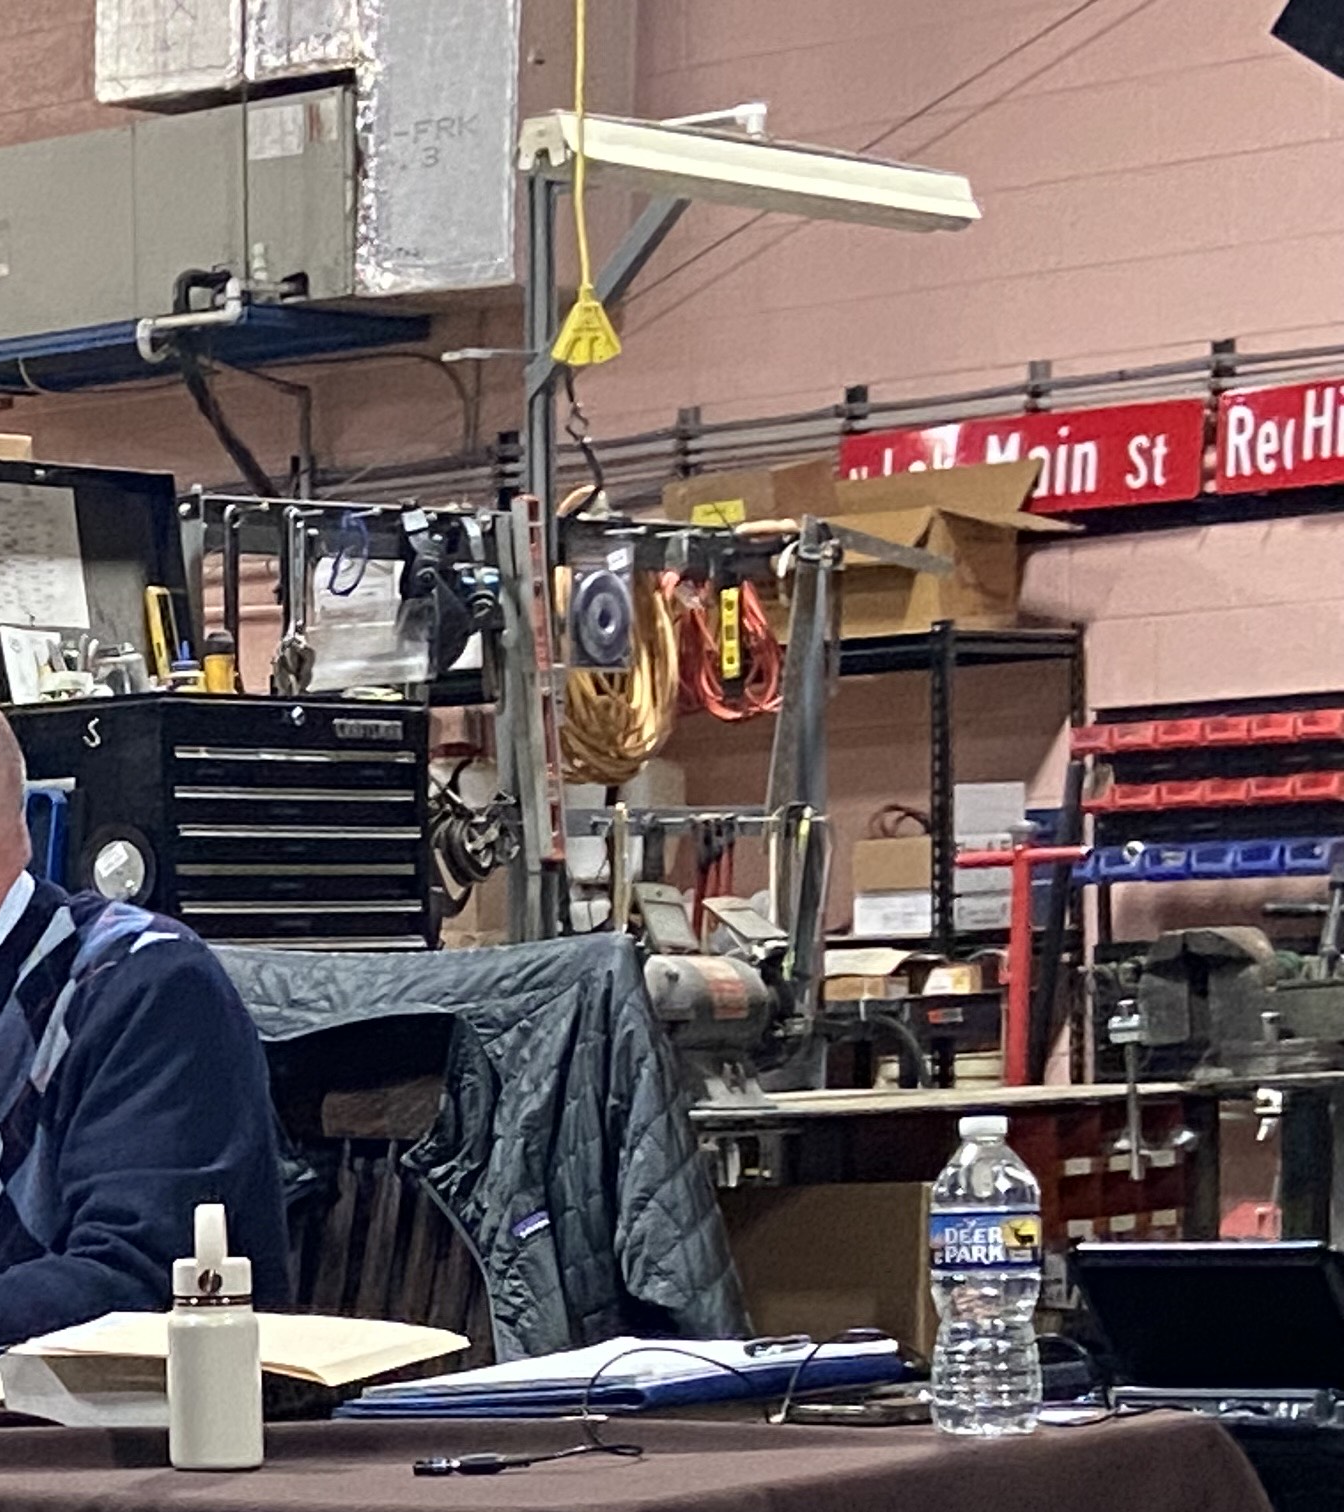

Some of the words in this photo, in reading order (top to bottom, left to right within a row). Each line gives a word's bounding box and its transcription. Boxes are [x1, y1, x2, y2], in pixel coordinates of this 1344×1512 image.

[1124, 433, 1168, 490] St
[944, 1226, 1004, 1244] DEER
[944, 1244, 1006, 1265] PARK
